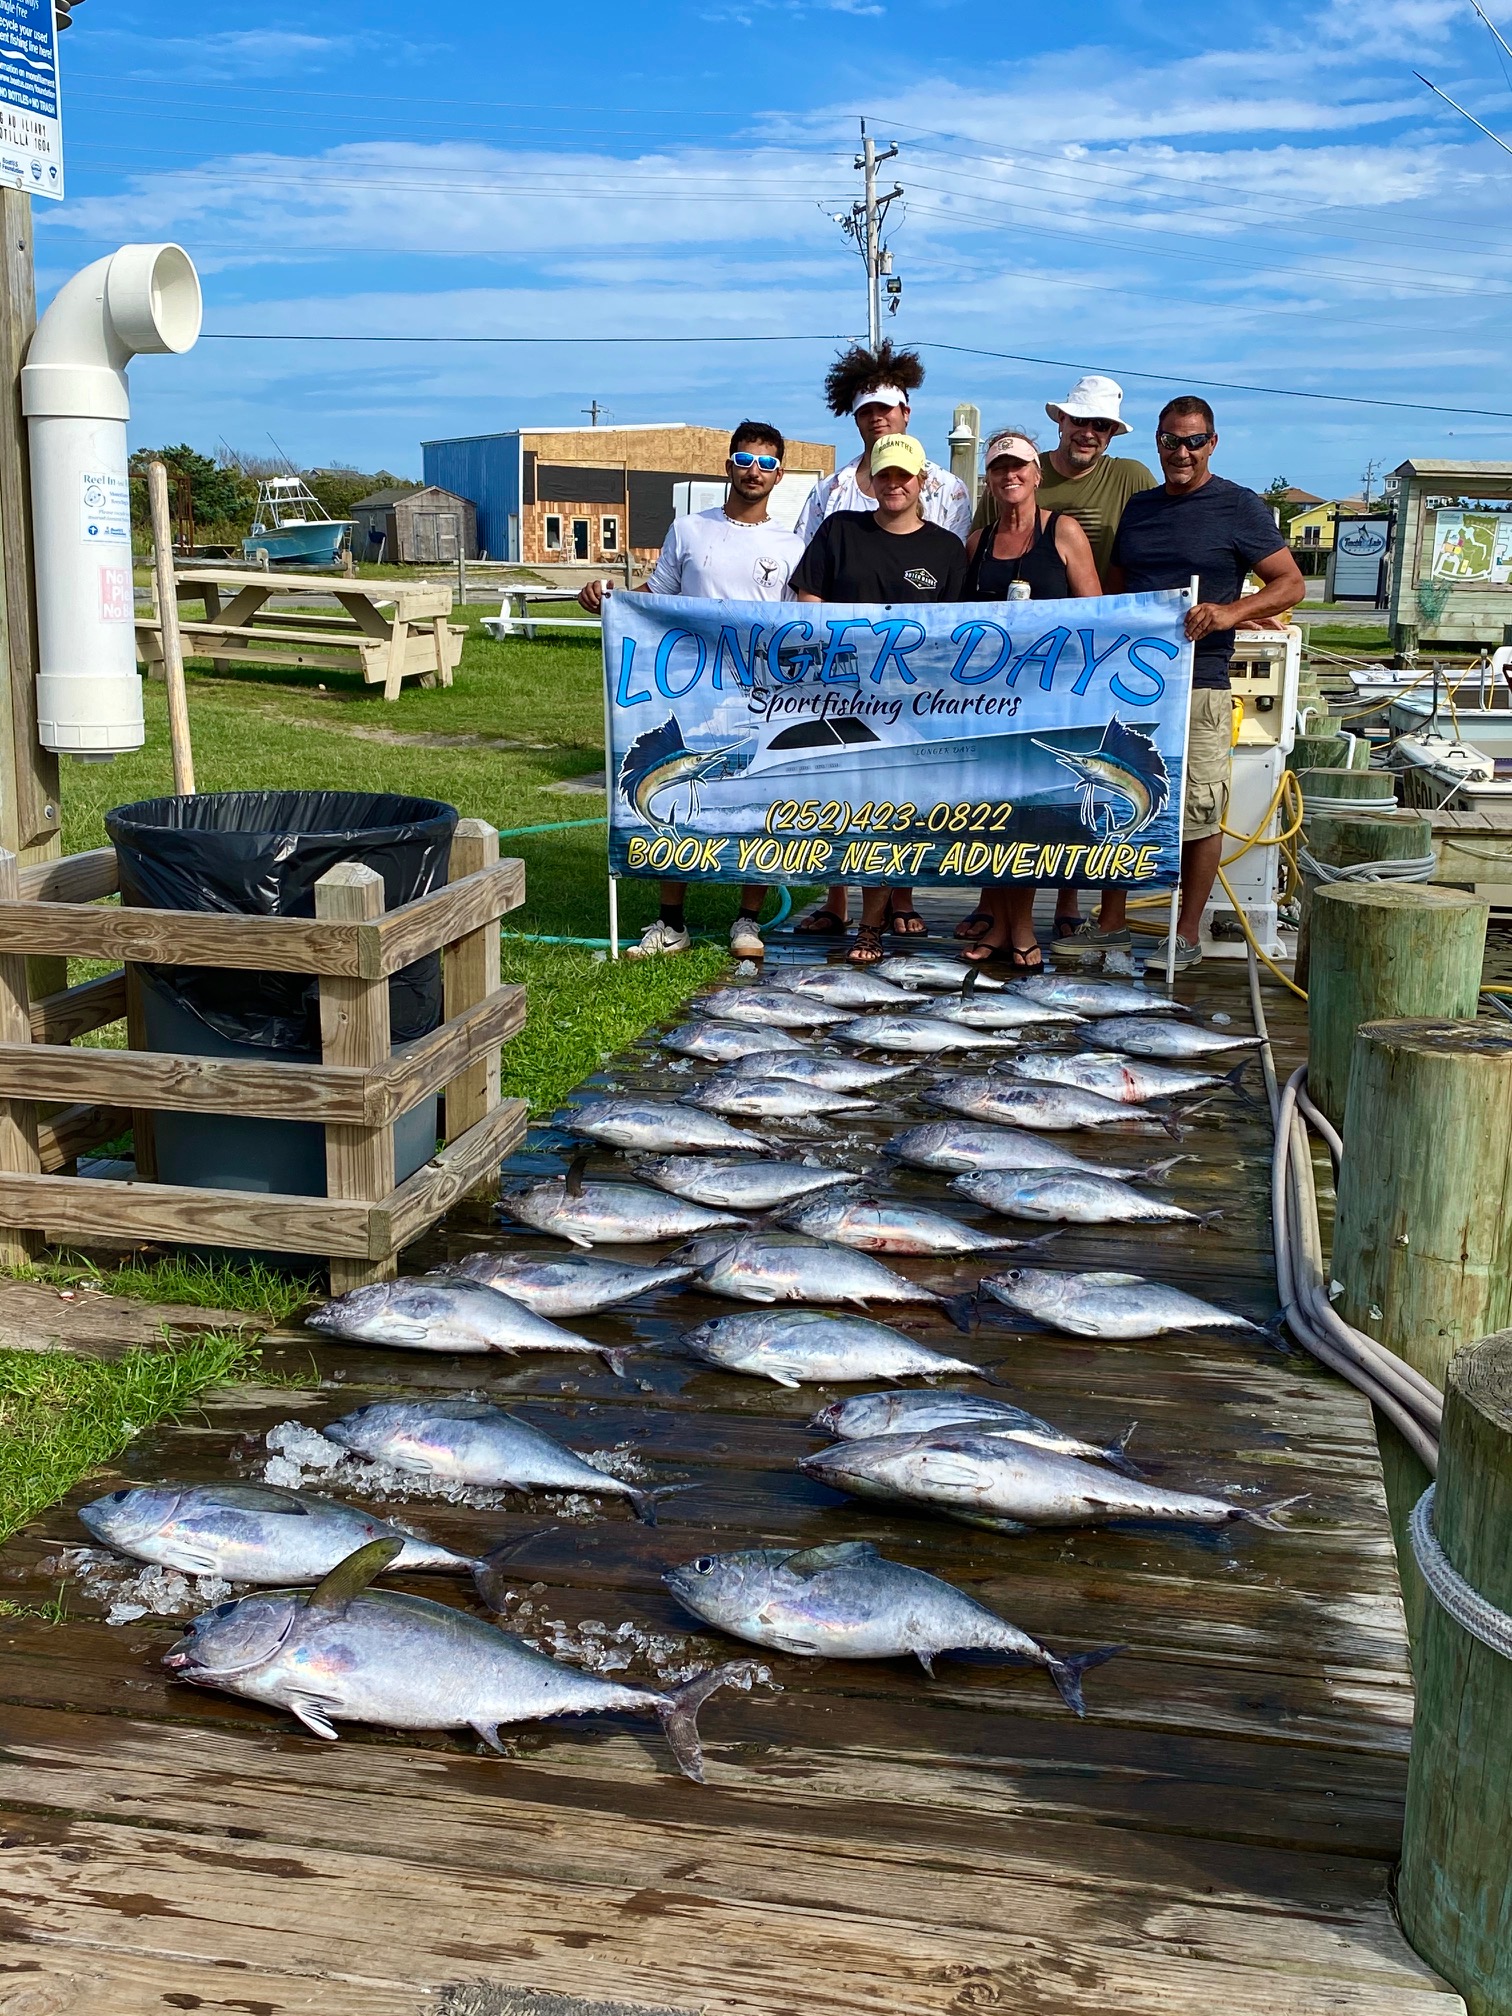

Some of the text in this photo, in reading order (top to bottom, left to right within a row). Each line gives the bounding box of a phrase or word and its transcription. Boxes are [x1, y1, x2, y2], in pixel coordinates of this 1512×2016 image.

[10, 33, 28, 52] fishing
[29, 40, 38, 54] line
[19, 24, 33, 37] your
[33, 30, 48, 44] used
[8, 88, 29, 106] BOTTLES
[32, 97, 39, 109] NO
[40, 100, 55, 114] TRASH
[84, 475, 105, 484] Reel
[107, 476, 115, 486] In
[105, 570, 124, 585] No
[103, 603, 121, 618] No
[616, 618, 1179, 708] LONGER DAYS
[747, 686, 1022, 725] Sportfishing Charters
[915, 745, 976, 756] LONGER DAYS
[765, 799, 1012, 836] (252)423-0822
[627, 836, 1163, 881] BOOK YOUR NEXT ADVENTURE
